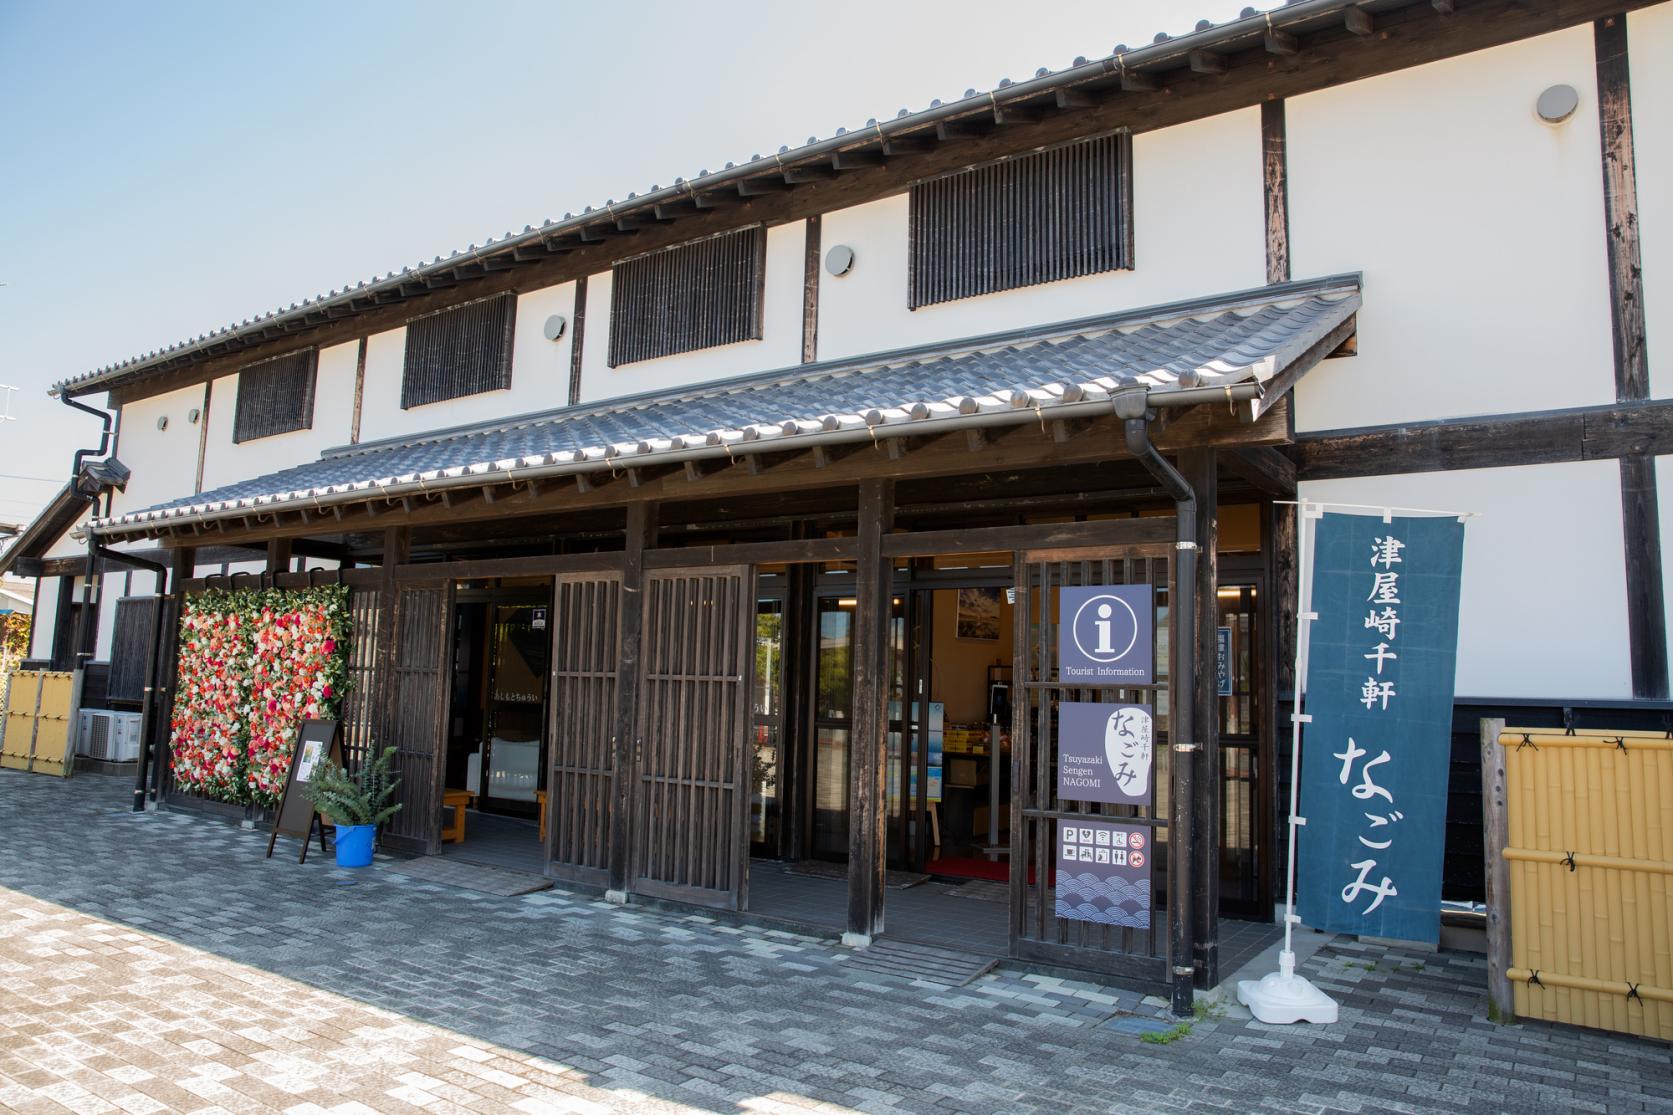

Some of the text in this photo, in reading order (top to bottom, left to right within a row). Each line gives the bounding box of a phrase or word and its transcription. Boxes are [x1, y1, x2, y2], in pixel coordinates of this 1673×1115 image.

[1066, 666, 1145, 676] Tourist Information
[1333, 536, 1406, 916] 津屋崎千軒 なごみ
[1111, 710, 1139, 787] なごみ
[1062, 753, 1103, 765] Tsuyazaki
[1063, 765, 1093, 776] Sengen
[1063, 777, 1101, 788] NAGOMI
